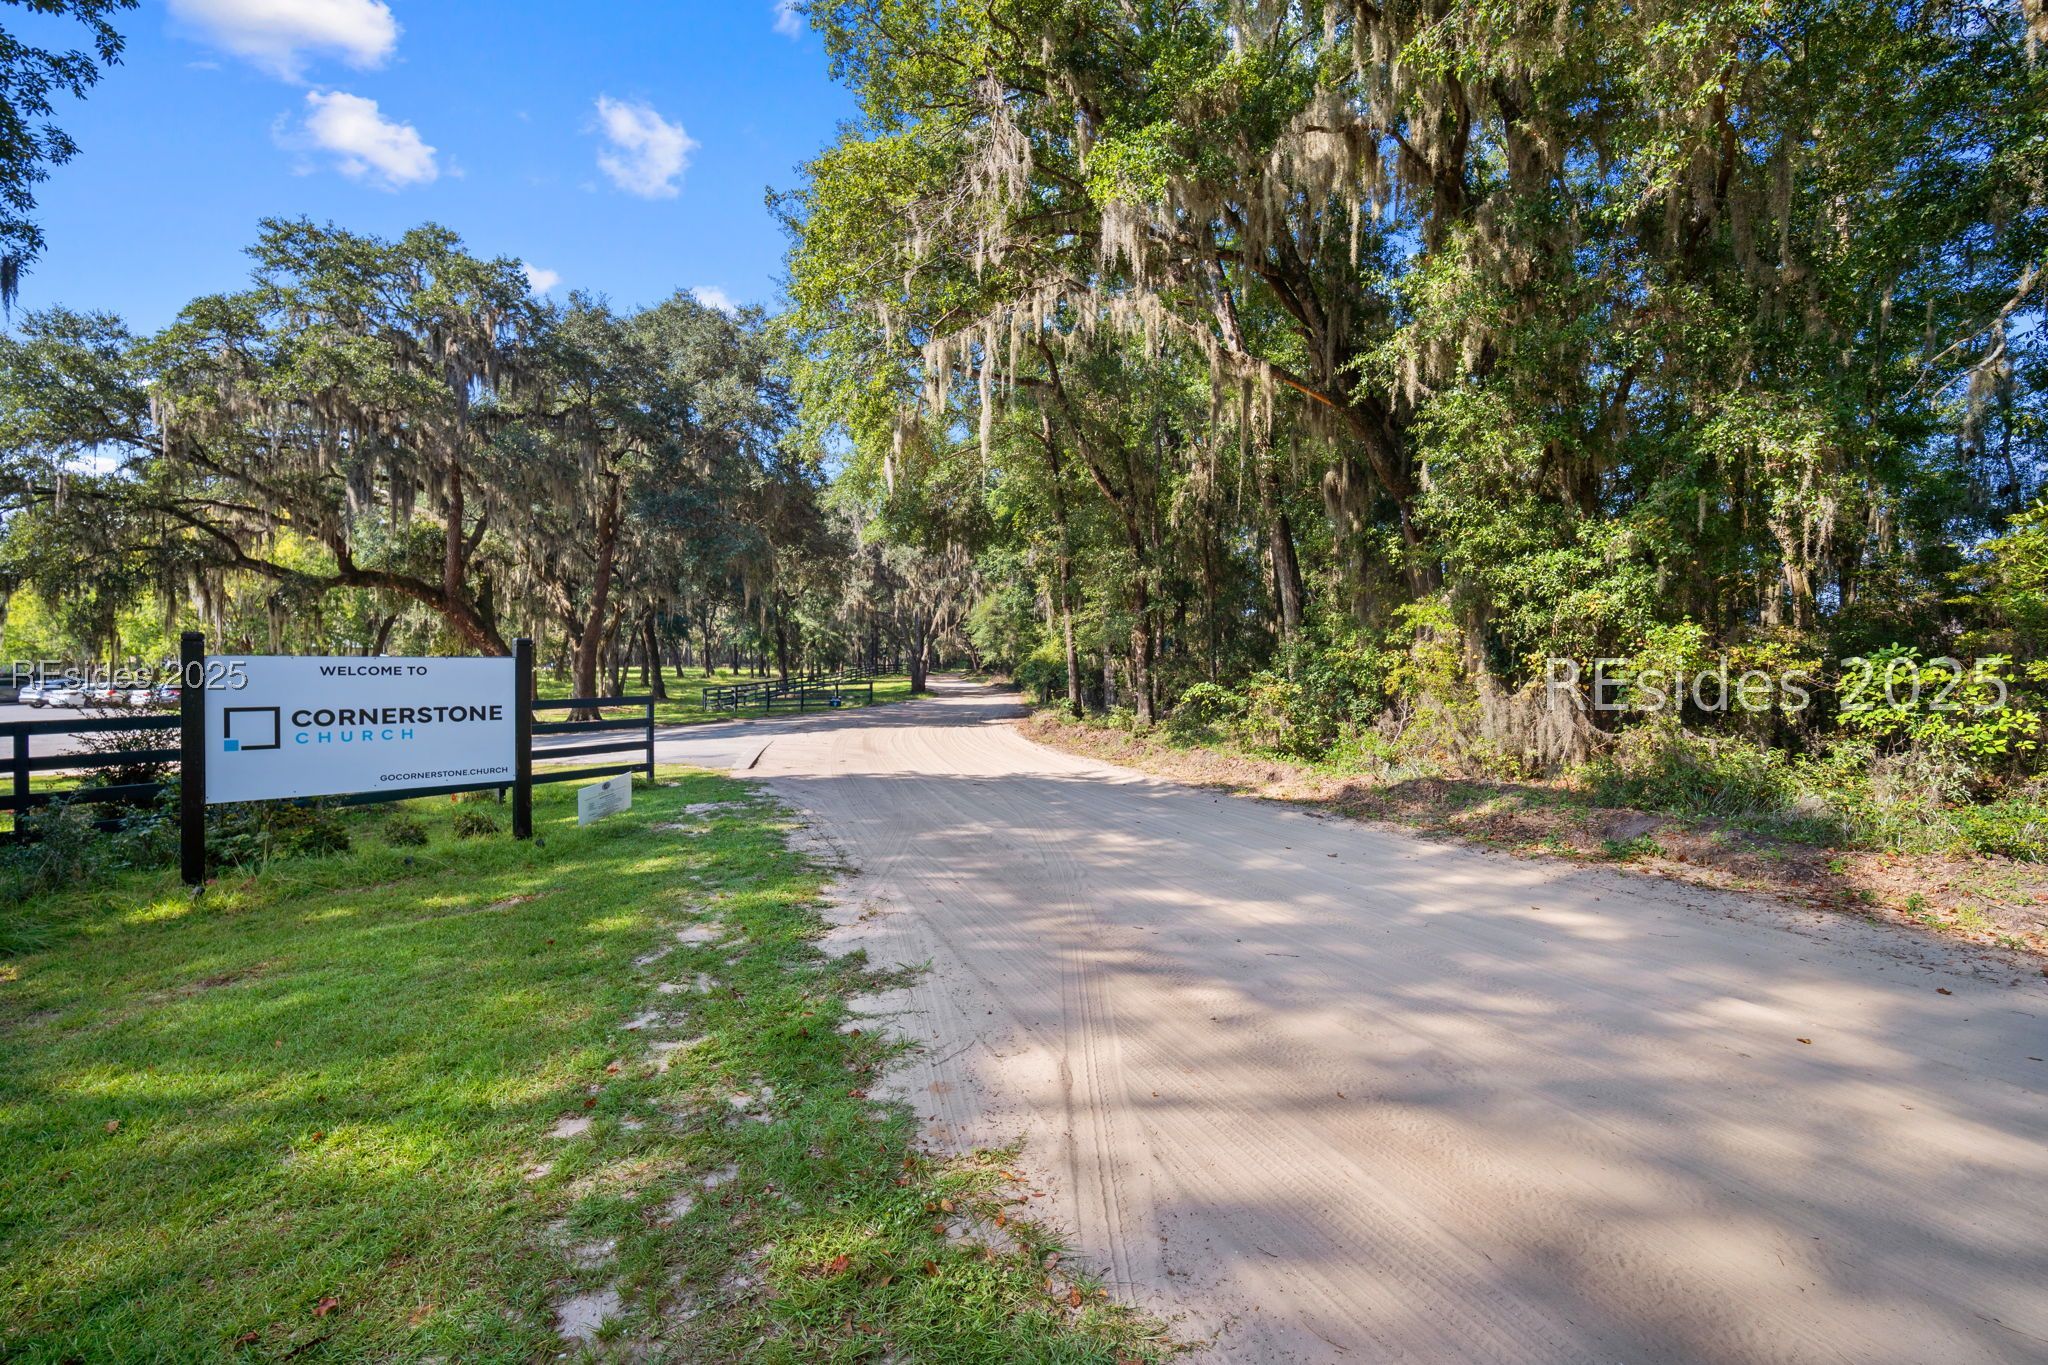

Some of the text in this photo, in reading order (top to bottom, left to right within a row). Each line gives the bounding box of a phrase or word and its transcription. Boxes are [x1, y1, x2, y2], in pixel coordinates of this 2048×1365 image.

[320, 666, 428, 676] WELCOME TO
[291, 705, 503, 728] CORNERSTONE
[295, 728, 414, 744] CHURCH
[380, 766, 509, 782] GOCORNERSTONE.CHURCH
